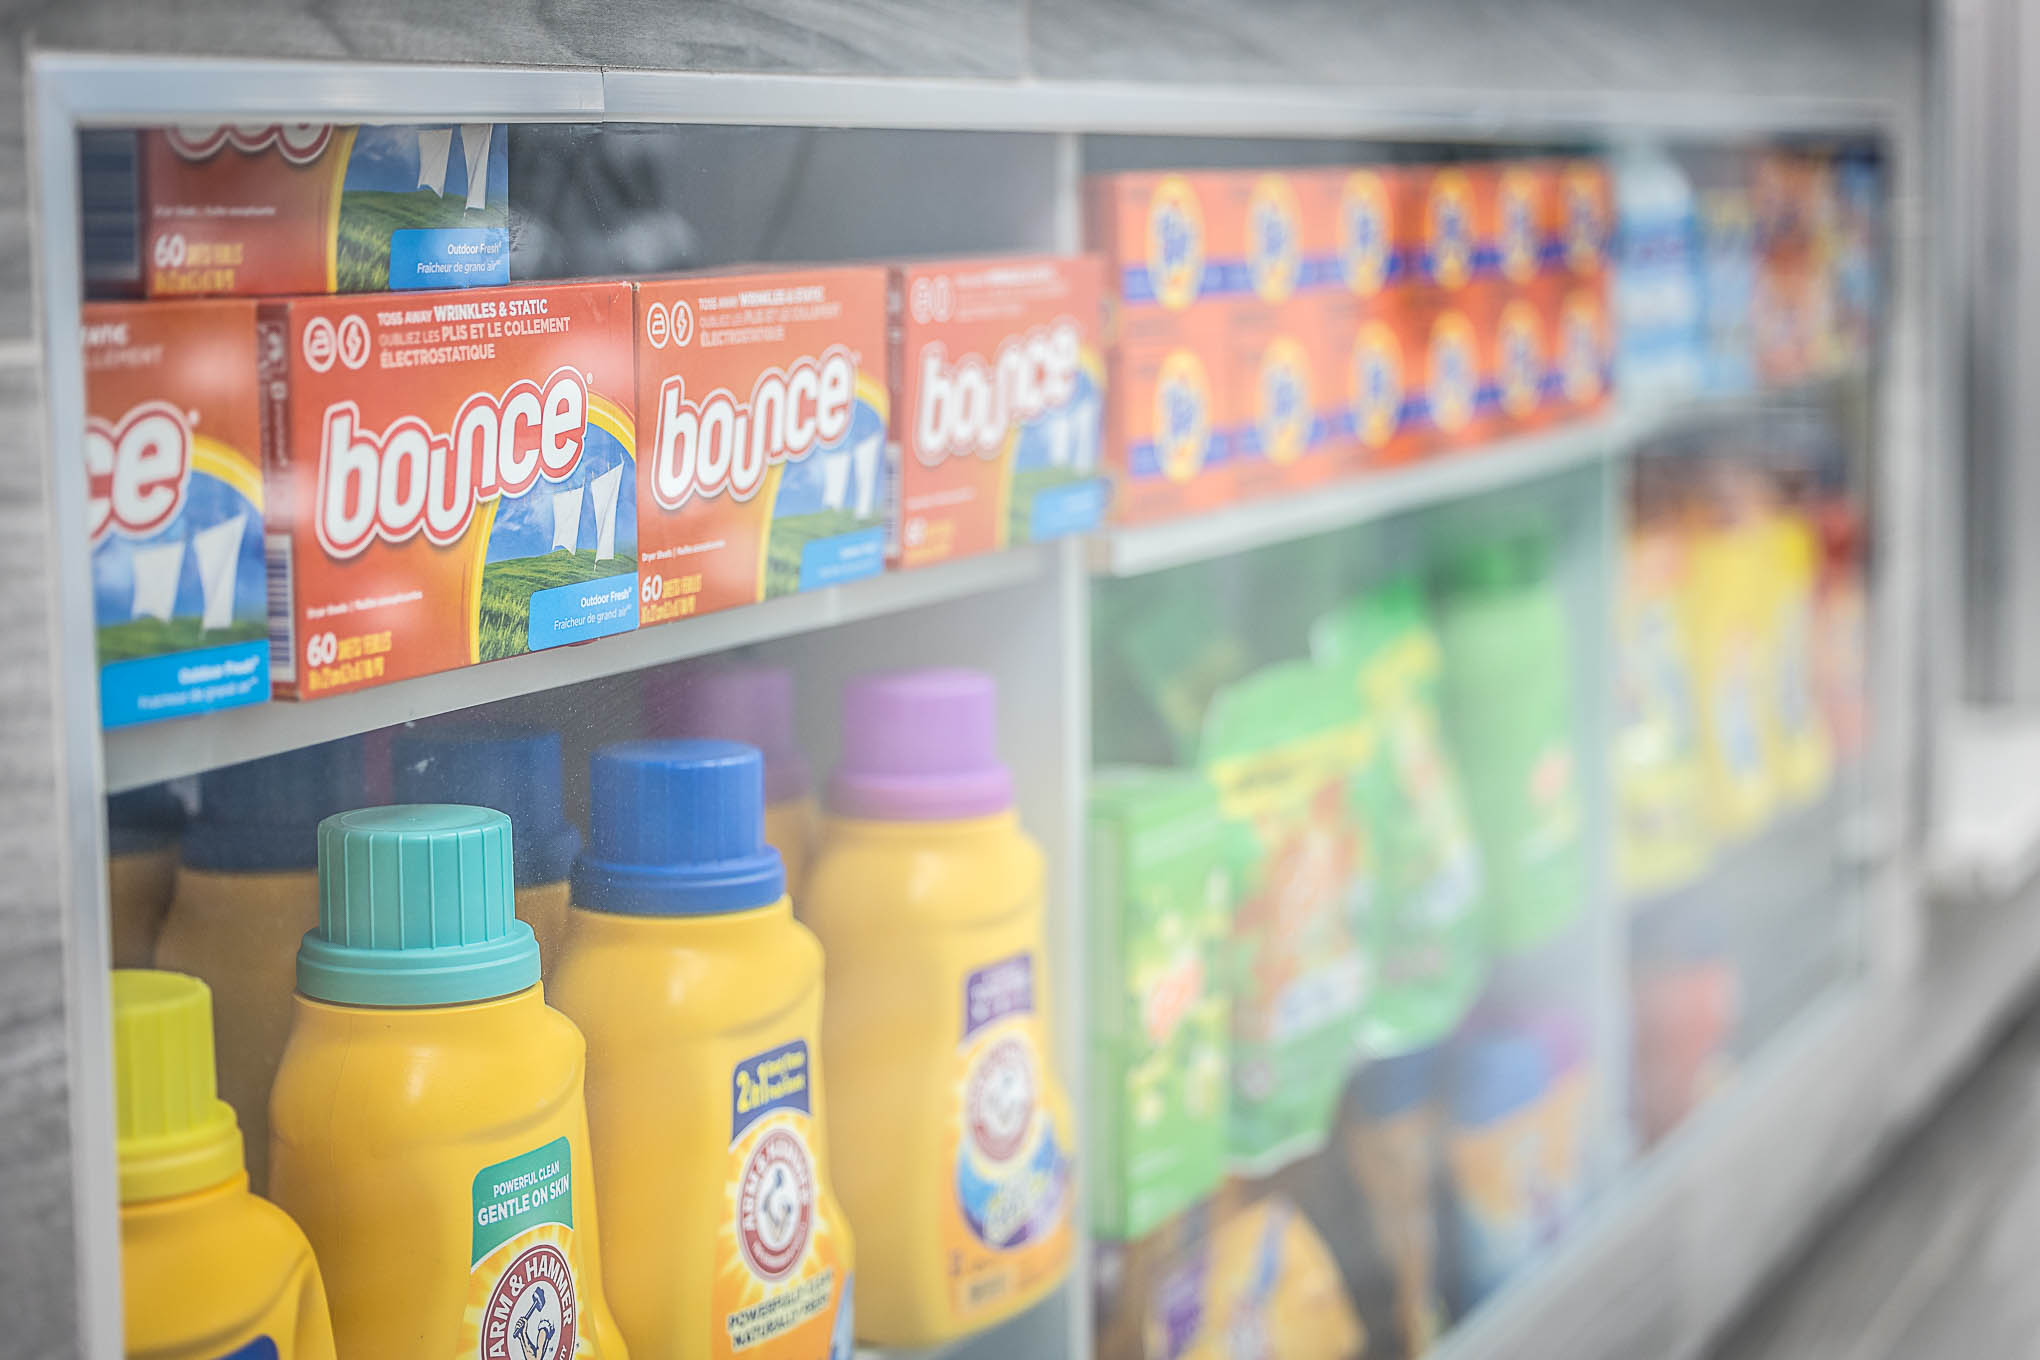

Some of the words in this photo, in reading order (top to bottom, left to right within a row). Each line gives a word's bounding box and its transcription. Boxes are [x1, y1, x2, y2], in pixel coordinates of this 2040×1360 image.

[154, 233, 185, 267] 60
[447, 244, 479, 255] Outdoor
[434, 302, 496, 322] WRINKLES
[498, 301, 508, 317] &
[508, 299, 548, 316] STATIC
[441, 324, 467, 342] PLIS
[469, 322, 485, 340] ET
[487, 322, 503, 338] LE
[503, 317, 571, 337] COLLEMENT
[653, 346, 851, 510] bounce
[315, 365, 589, 558] bounce
[580, 592, 611, 608] Outdoor
[641, 574, 663, 602] 60
[307, 632, 337, 667] 60
[493, 1172, 538, 1198] POWERFUL
[538, 1160, 560, 1181] CLEAN
[478, 1193, 530, 1226] GENTLE
[531, 1185, 549, 1207] ON
[549, 1174, 570, 1199] SKIN
[489, 1293, 514, 1357] ARM
[509, 1274, 526, 1296] &
[525, 1254, 573, 1327] HAMMER
